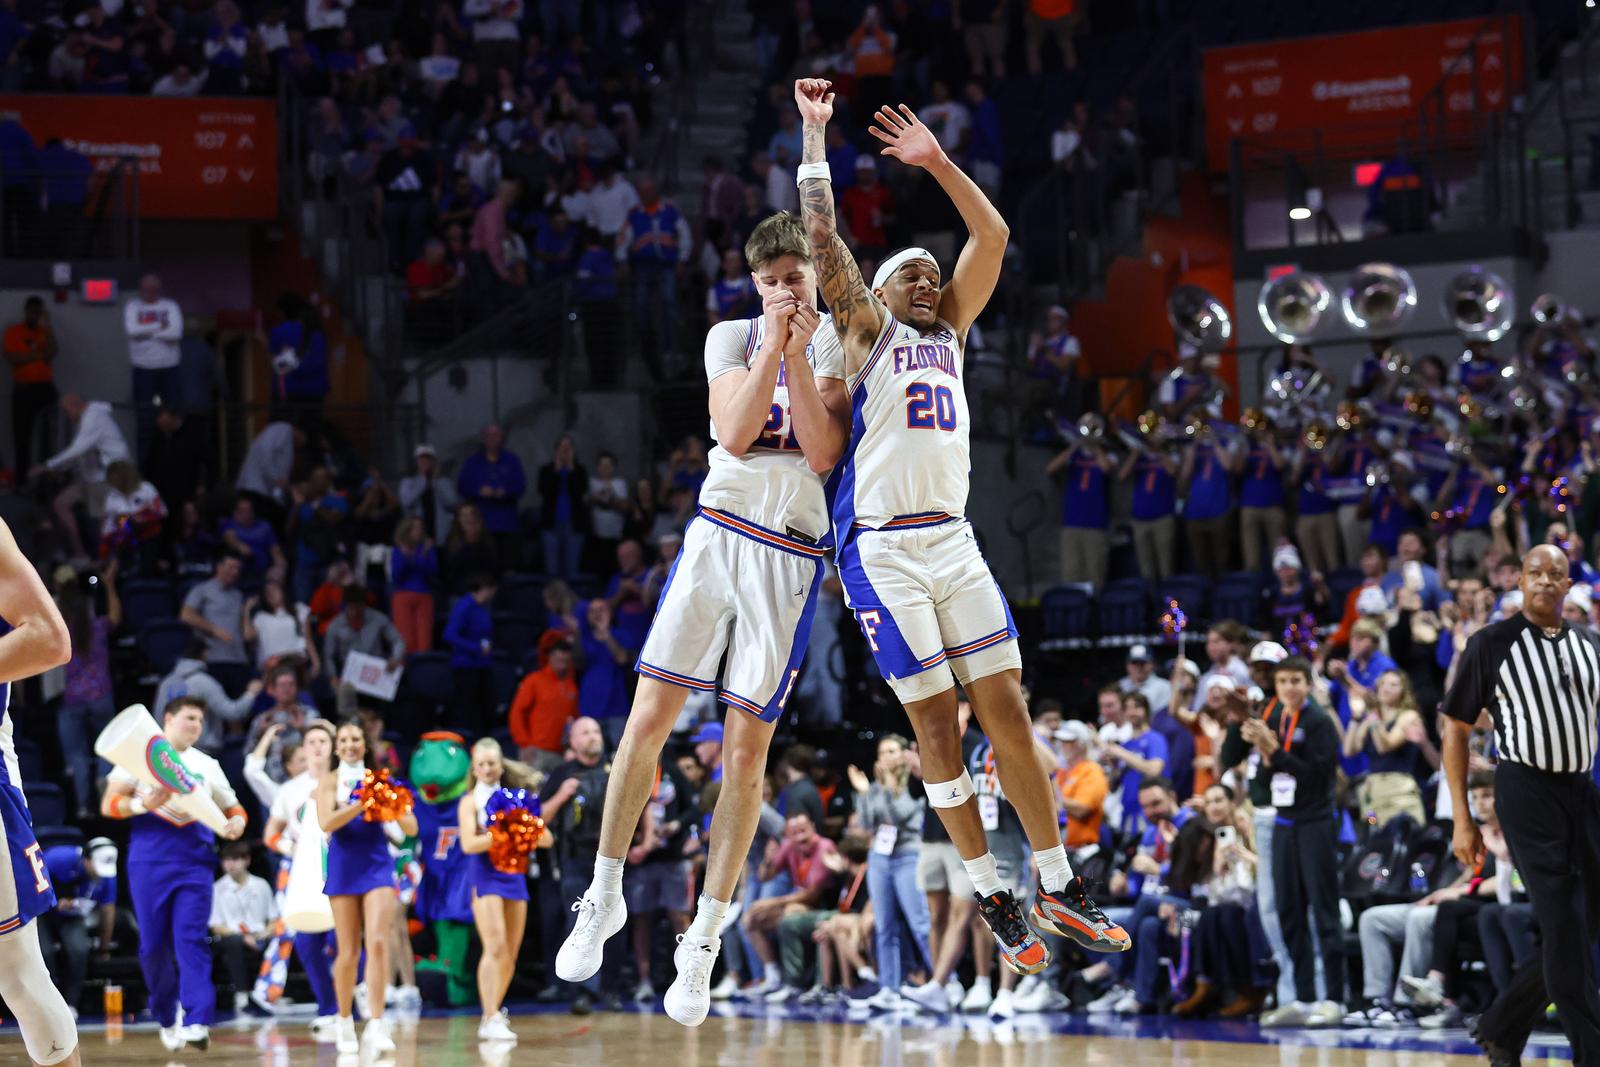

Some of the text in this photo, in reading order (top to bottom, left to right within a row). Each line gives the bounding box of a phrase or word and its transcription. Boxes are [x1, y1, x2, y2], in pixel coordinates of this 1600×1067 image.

[194, 131, 228, 149] 107
[201, 165, 228, 184] 07
[893, 343, 958, 380] FLORIDA
[905, 381, 957, 432] 20
[860, 609, 881, 652] F
[433, 826, 460, 861] F
[24, 841, 50, 895] F
